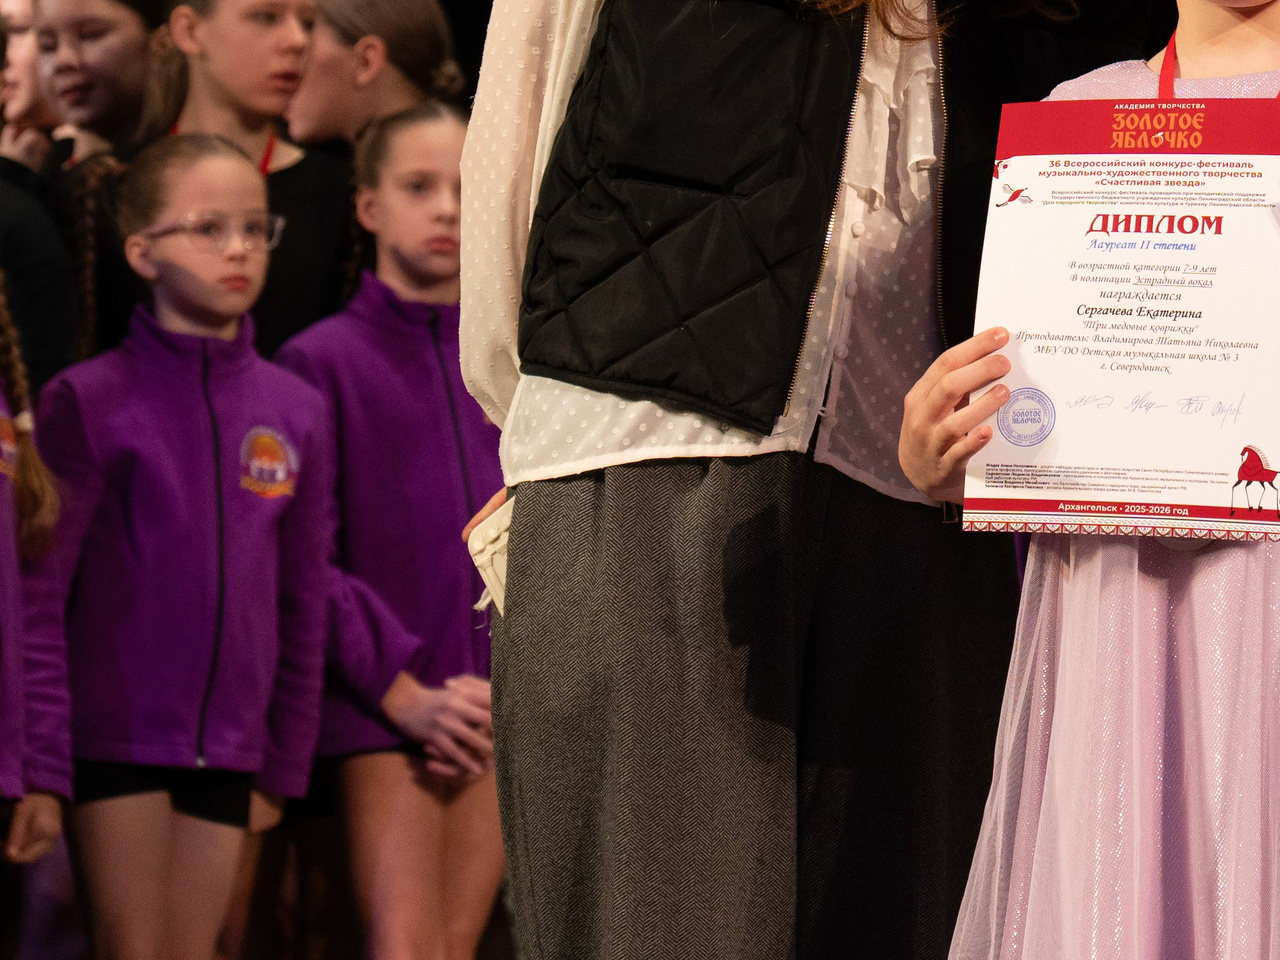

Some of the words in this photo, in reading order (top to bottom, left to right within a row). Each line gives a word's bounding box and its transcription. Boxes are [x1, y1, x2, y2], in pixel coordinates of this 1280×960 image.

[1111, 112, 1205, 130] ЗОЛОТОЕ
[1109, 130, 1203, 149] ЯБЛОЧКО
[1048, 160, 1061, 168] 36
[1063, 159, 1146, 168] Всероссийский
[1149, 160, 1254, 169] конкурс-фестиваль
[1038, 169, 1200, 178] музыкально-художественного
[1202, 170, 1263, 179] творчества
[1095, 178, 1161, 186] «Счастливая
[1164, 179, 1206, 187] звезда»
[1085, 213, 1224, 237] ДИПЛОМ
[1086, 239, 1137, 252] Лауреат
[1153, 242, 1197, 251] степени
[1068, 260, 1077, 270] В
[1078, 262, 1131, 273] возрастной
[1132, 263, 1181, 274] категории
[1183, 263, 1198, 273] 7-9
[1199, 265, 1217, 274] лет
[1069, 273, 1078, 283] В
[1079, 275, 1131, 285] номинации
[1133, 275, 1186, 287] Эстрадный
[1187, 279, 1214, 288] вокал
[1099, 288, 1182, 302] награждается
[1077, 304, 1133, 318] Сергачева
[1135, 306, 1203, 321] Екатерина
[1082, 320, 1107, 331] "Три
[1109, 321, 1148, 331] медовые
[1150, 324, 1200, 334] коврижки"
[1016, 331, 1088, 342] Преподаватель:
[1091, 333, 1154, 346] Владимирова
[1155, 336, 1202, 347] Татьяна
[1203, 338, 1259, 350] Николаевна
[1034, 345, 1061, 356] МБУ
[1062, 346, 1079, 355] ДО
[1080, 346, 1122, 358] Детская
[1123, 350, 1186, 360] музыкальная
[1188, 353, 1217, 362] школа
[1233, 353, 1239, 362] 3
[1109, 361, 1172, 374] Северодвинск
[1057, 502, 1118, 512] Архангельск
[1124, 504, 1171, 514] 2025-2026
[1172, 507, 1189, 515] год
